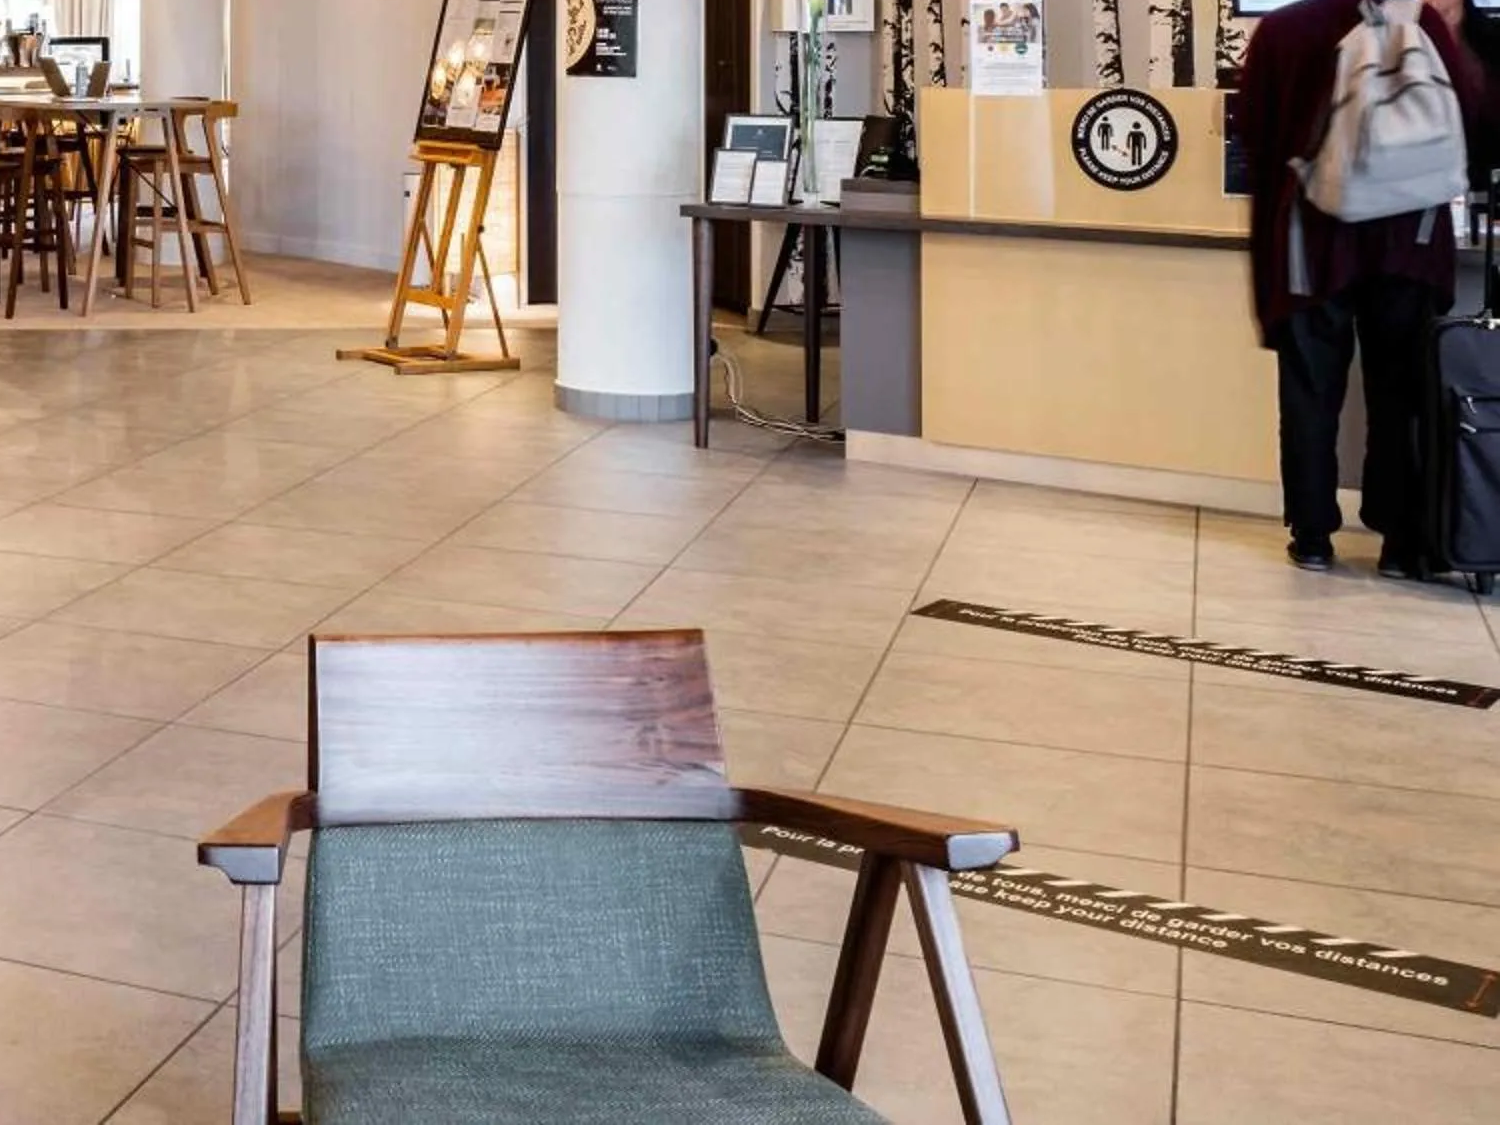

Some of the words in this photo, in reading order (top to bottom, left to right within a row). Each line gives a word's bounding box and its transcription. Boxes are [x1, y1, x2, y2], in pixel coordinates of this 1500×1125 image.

[760, 825, 813, 843] Pour
[815, 836, 837, 848] la
[992, 889, 1051, 910] keep
[1053, 902, 1117, 923] your
[1119, 915, 1229, 949] distance
[992, 877, 1047, 899] tous,
[1055, 891, 1128, 915] merci
[1130, 909, 1161, 922] de
[1165, 916, 1253, 942] garder
[1260, 937, 1307, 955] vos
[1314, 948, 1449, 987] distances
